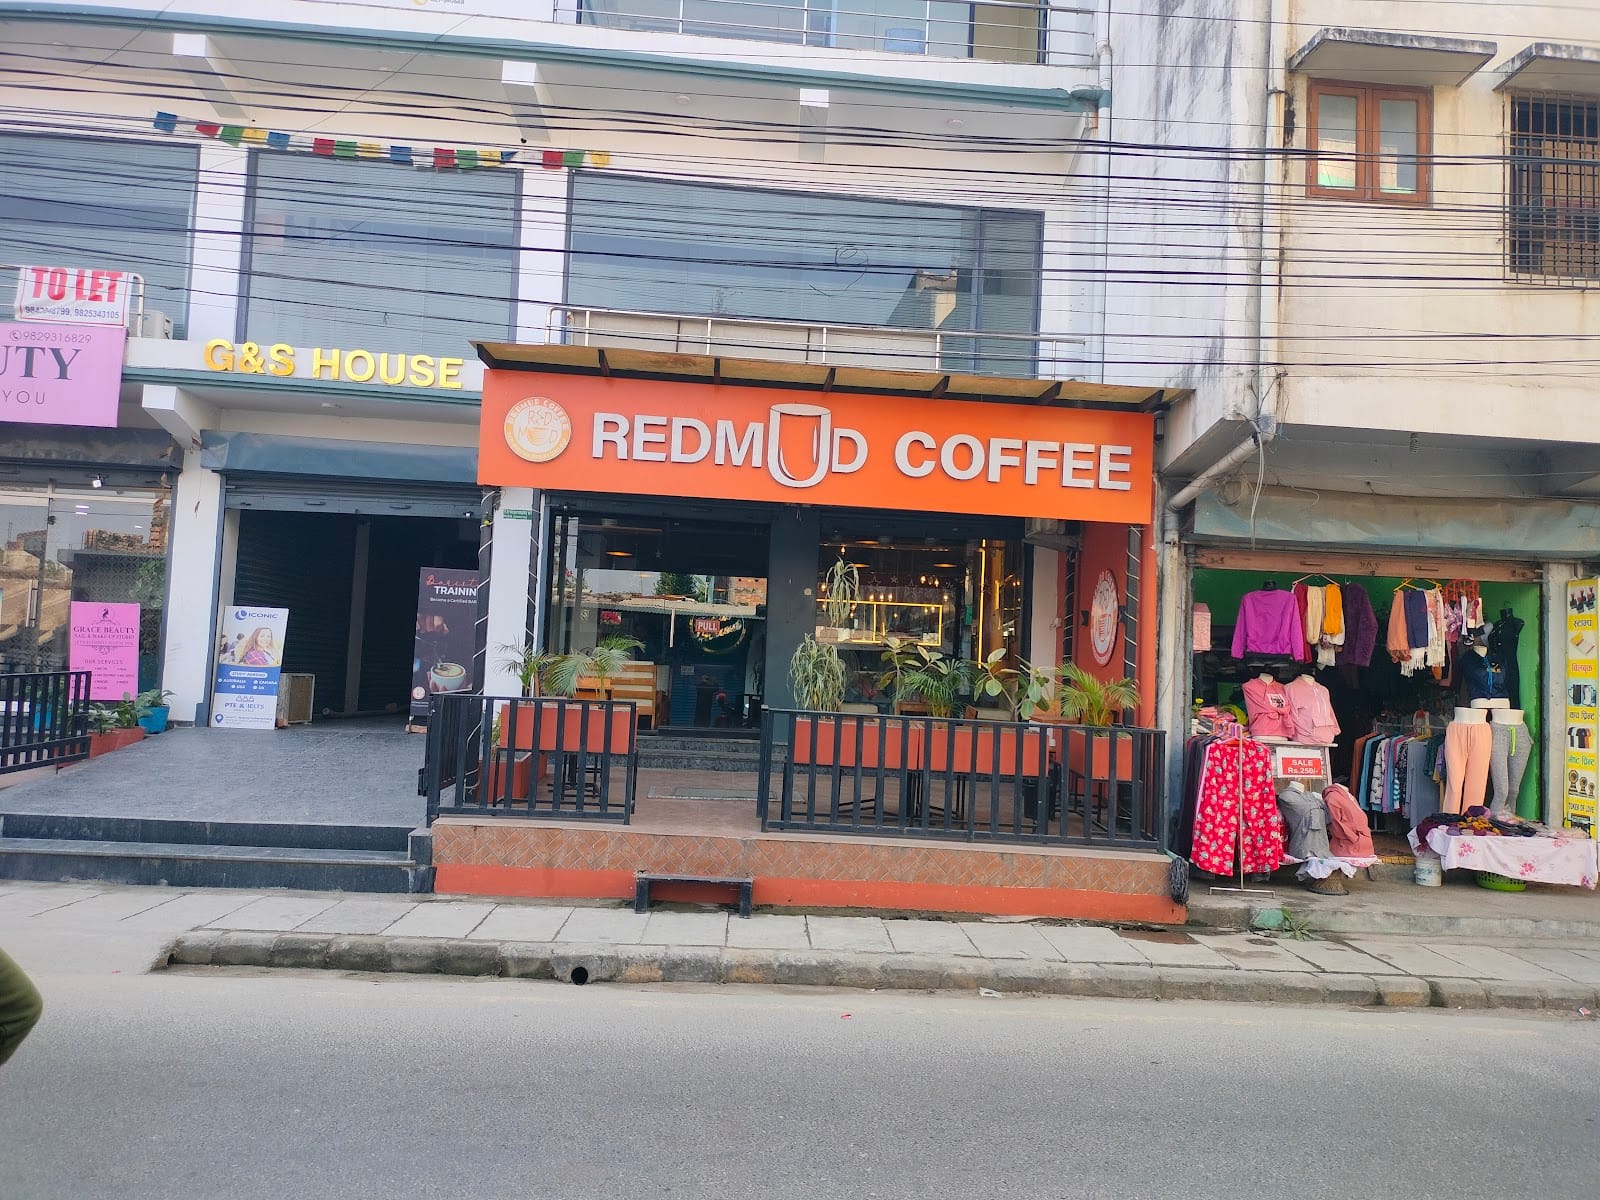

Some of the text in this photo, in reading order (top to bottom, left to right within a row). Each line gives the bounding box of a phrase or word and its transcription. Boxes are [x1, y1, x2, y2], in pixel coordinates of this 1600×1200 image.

[31, 266, 123, 303] TO LET
[74, 308, 120, 319] 9825343105
[23, 331, 92, 344] 9829316829
[203, 338, 464, 390] G&S HOUSE
[3, 390, 46, 405] YOU
[591, 403, 1132, 491] REDMUD COFFEE
[73, 626, 136, 635] GRACE BEAUTY
[698, 621, 717, 631] PULL
